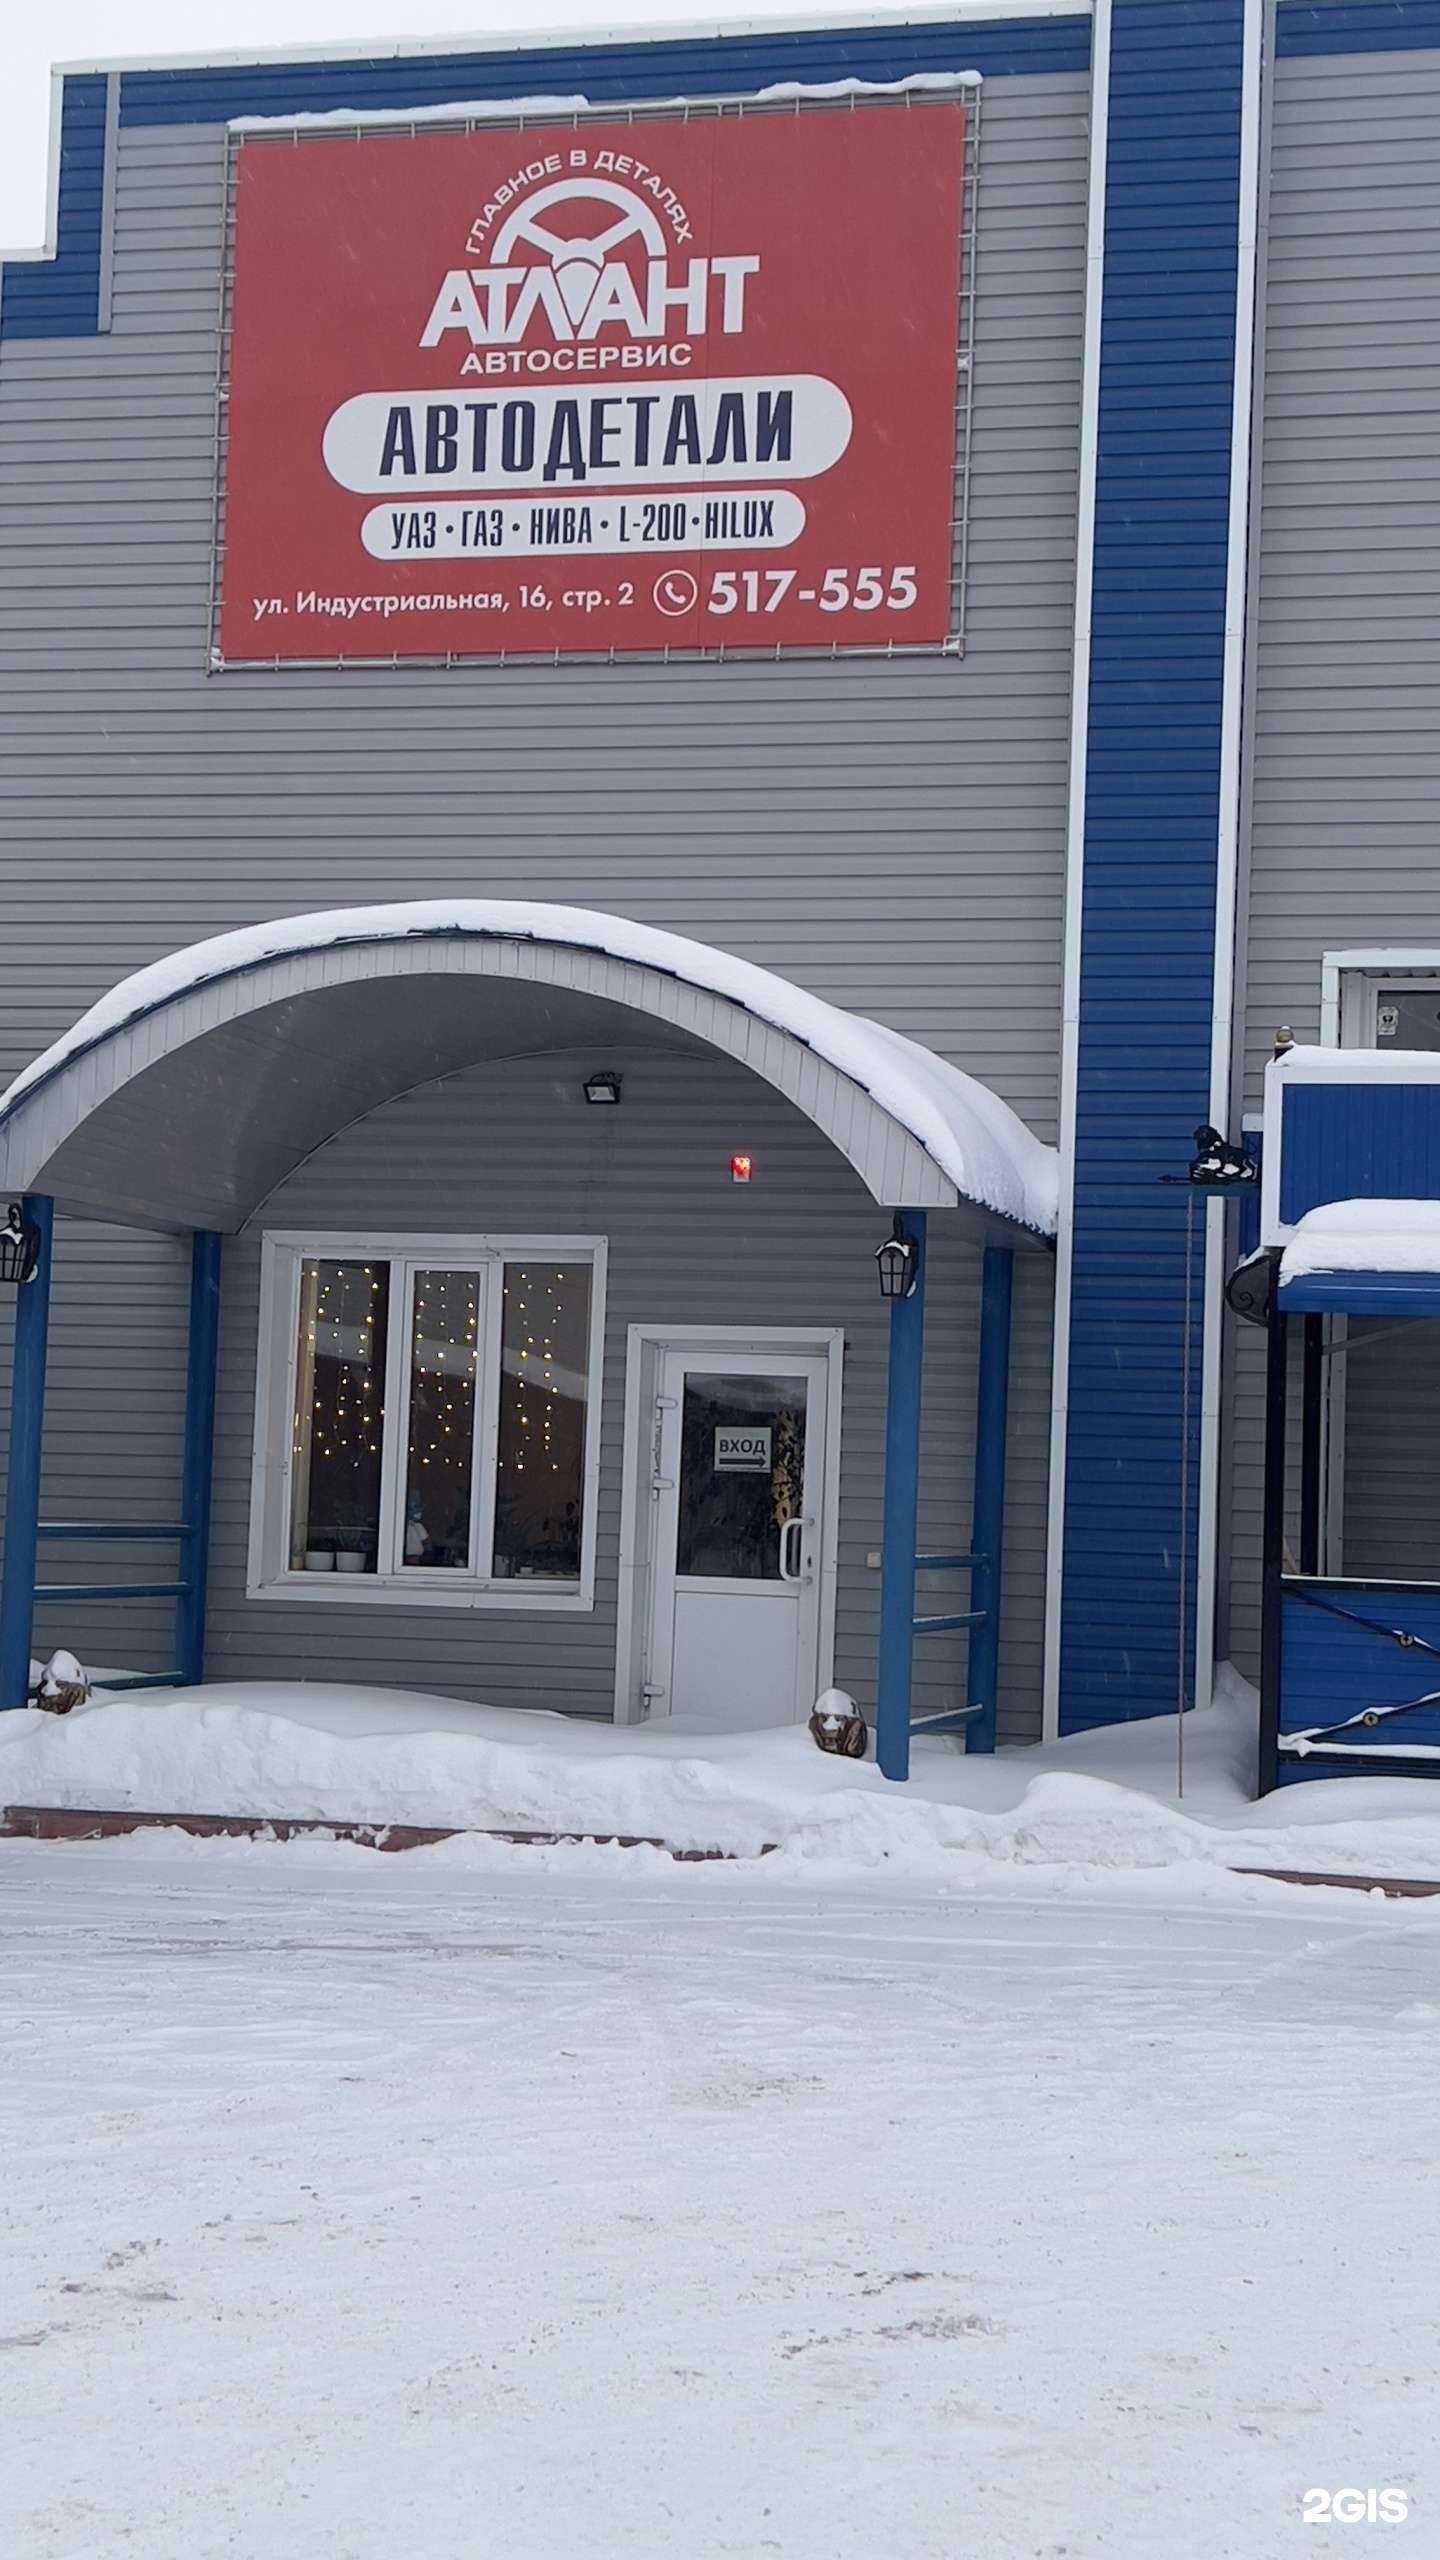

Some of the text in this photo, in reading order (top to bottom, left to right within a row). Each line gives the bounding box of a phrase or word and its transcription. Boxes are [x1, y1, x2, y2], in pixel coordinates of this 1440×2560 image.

[465, 149, 693, 255] ГЛАВНОЕ В ДЕТАЛЯХ
[418, 255, 760, 347] АТЛАНТ
[460, 343, 693, 376] АВТОСЕРВИС
[379, 390, 794, 481] АВТОДЕТАЛИ
[391, 500, 775, 550] УАЗ ГАЗ НИВА L-200 HILUX
[253, 582, 635, 621] ул. Индустриальная, 16, стр. 2
[707, 566, 918, 615] 517-555
[719, 1439, 766, 1456] ВХОД
